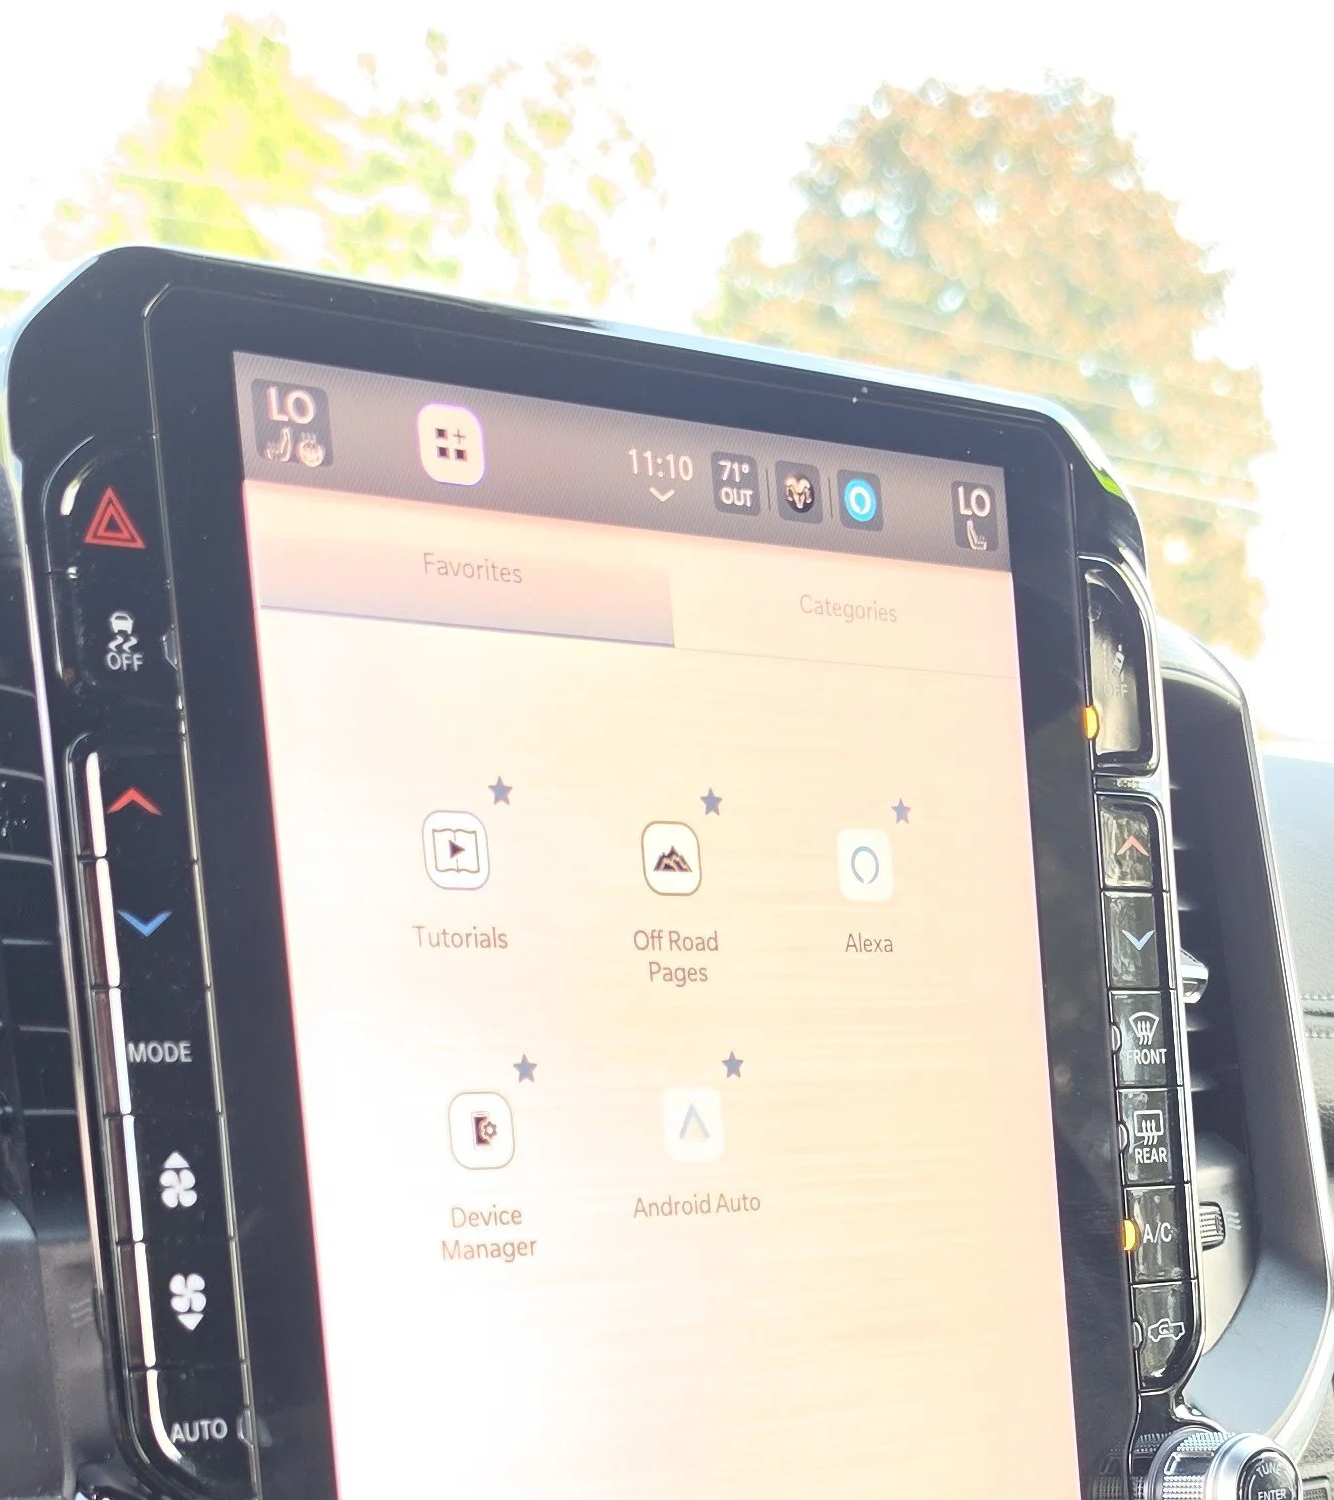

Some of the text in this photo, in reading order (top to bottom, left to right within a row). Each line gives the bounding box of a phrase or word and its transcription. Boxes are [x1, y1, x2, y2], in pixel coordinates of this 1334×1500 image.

[268, 386, 316, 425] LO
[627, 448, 694, 482] 11:10
[720, 487, 754, 508] OUT
[958, 485, 992, 517] LO
[422, 552, 523, 584] Favorites
[798, 594, 898, 624] Categories
[106, 651, 144, 673] OFF
[412, 925, 509, 951] Tutorials
[633, 929, 719, 952] Off Road
[845, 933, 894, 954] Alexa
[648, 961, 709, 988] Pages
[127, 1040, 193, 1065] MODE
[1127, 1047, 1167, 1066] FRONT
[1134, 1146, 1168, 1165] REAR
[450, 1205, 523, 1229] Device
[633, 1193, 761, 1219] Android Auto
[1142, 1221, 1173, 1244] A/C
[441, 1237, 537, 1264] Manager
[169, 1418, 229, 1444] AUTO
[1255, 1462, 1284, 1478] TUNE
